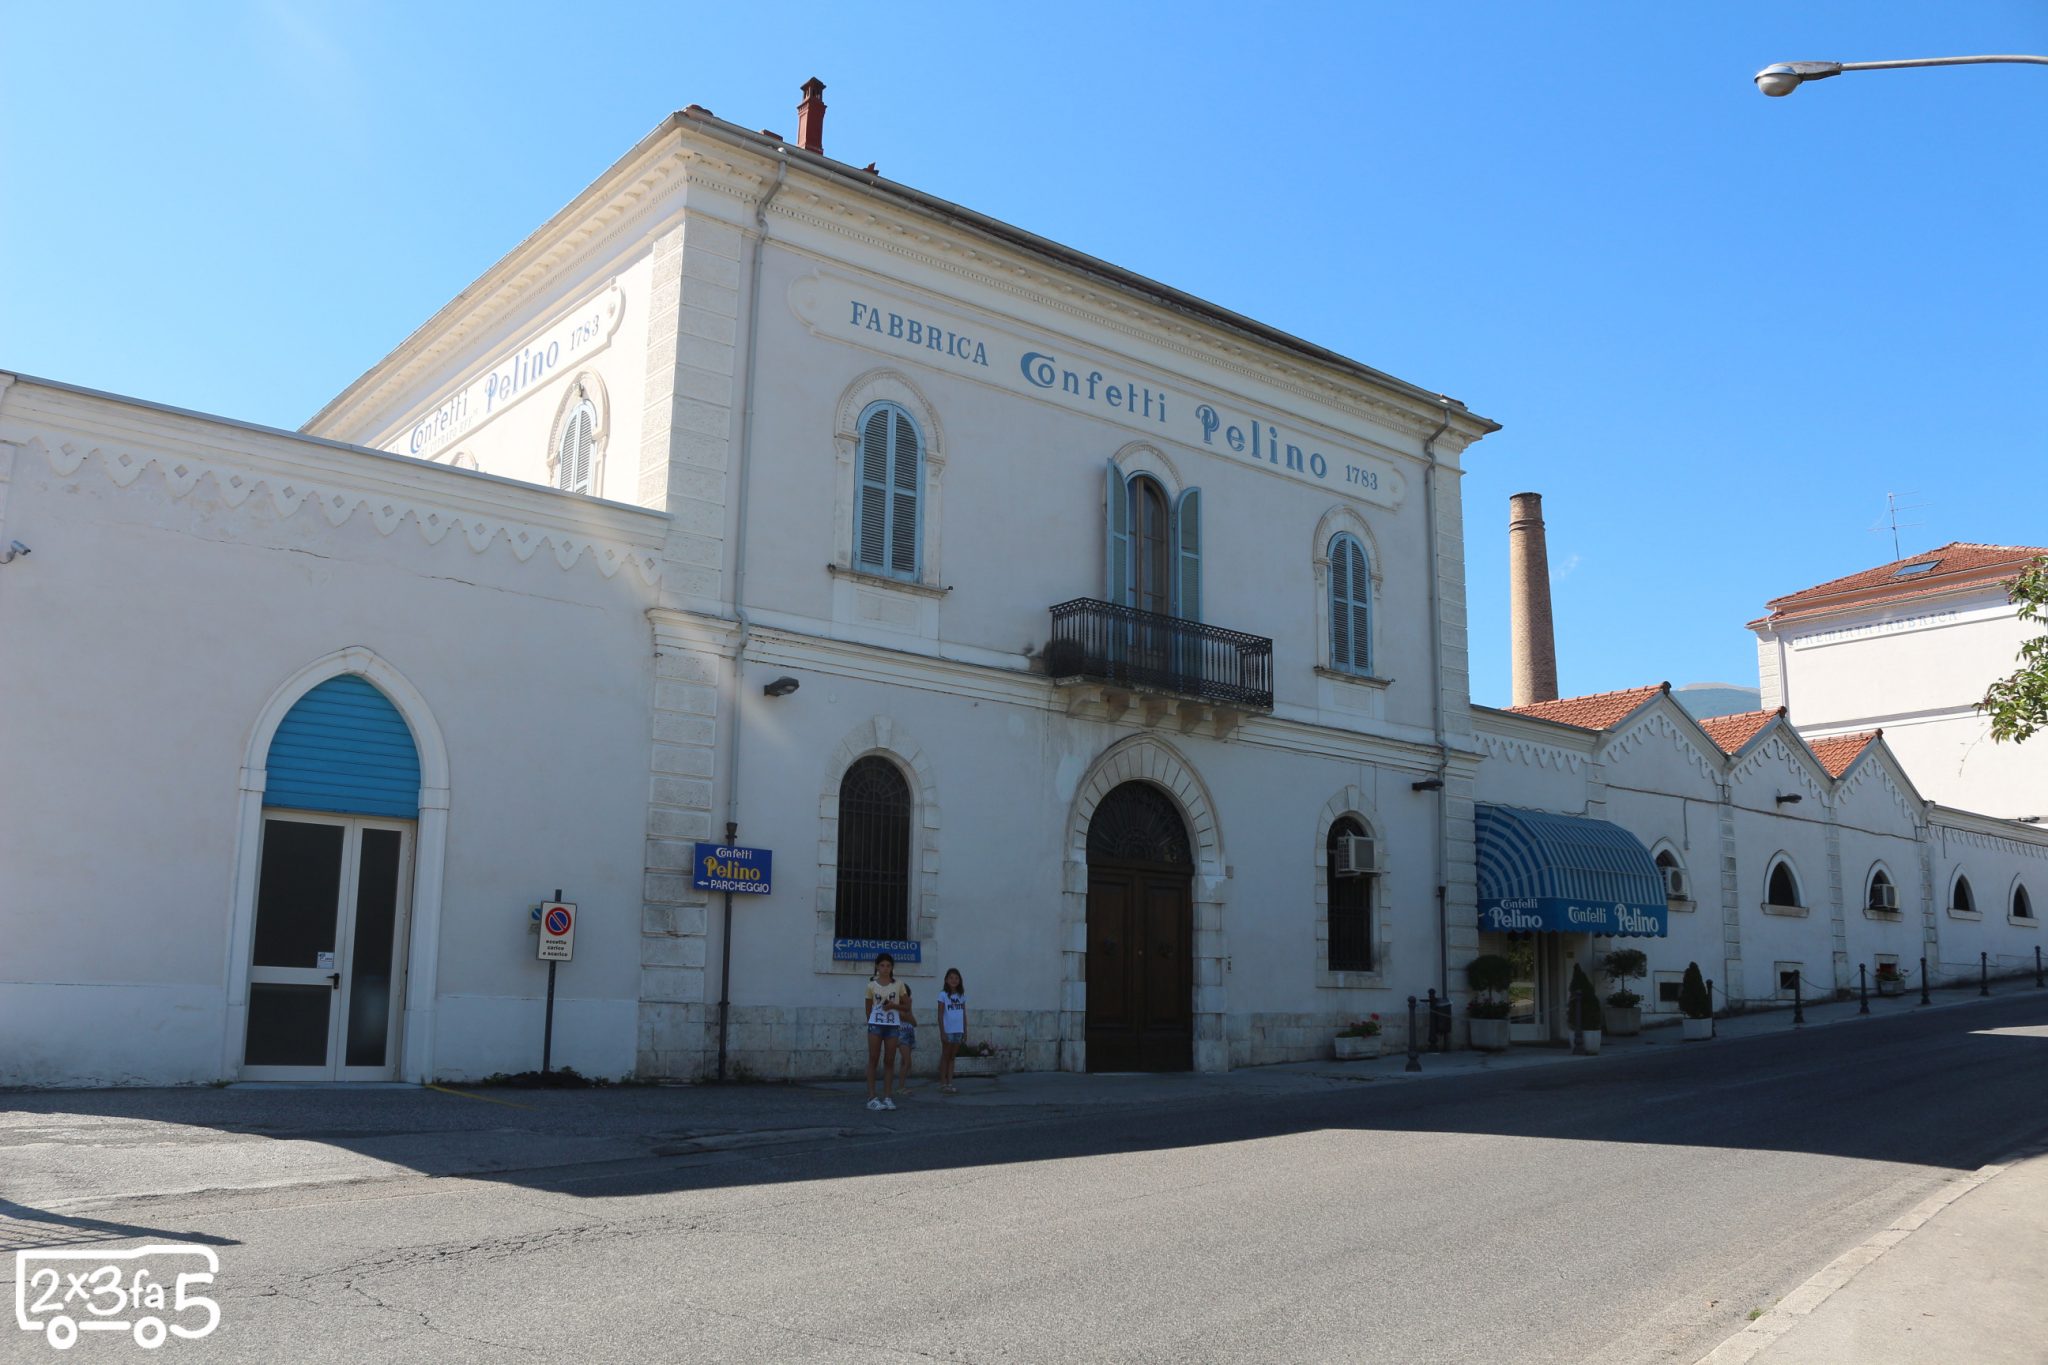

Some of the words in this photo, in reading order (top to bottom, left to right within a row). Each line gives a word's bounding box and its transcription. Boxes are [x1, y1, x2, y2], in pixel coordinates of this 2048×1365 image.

[410, 389, 468, 453] Confetti
[484, 341, 559, 413] Pelino
[569, 315, 600, 351] 1783
[850, 301, 989, 367] FABBRICA
[1020, 351, 1166, 423] Confetti
[1195, 404, 1328, 479] Pelino
[1345, 464, 1379, 491] 1783
[716, 847, 753, 860] Confetti
[703, 856, 760, 881] Pelino
[710, 879, 769, 893] PARCHEGGIO
[1501, 898, 1538, 910] Confetti
[1489, 906, 1543, 928] Pelino
[1568, 906, 1607, 924] Confetti
[1614, 903, 1659, 932] Pelino
[847, 939, 918, 951] PARCHEGGIO
